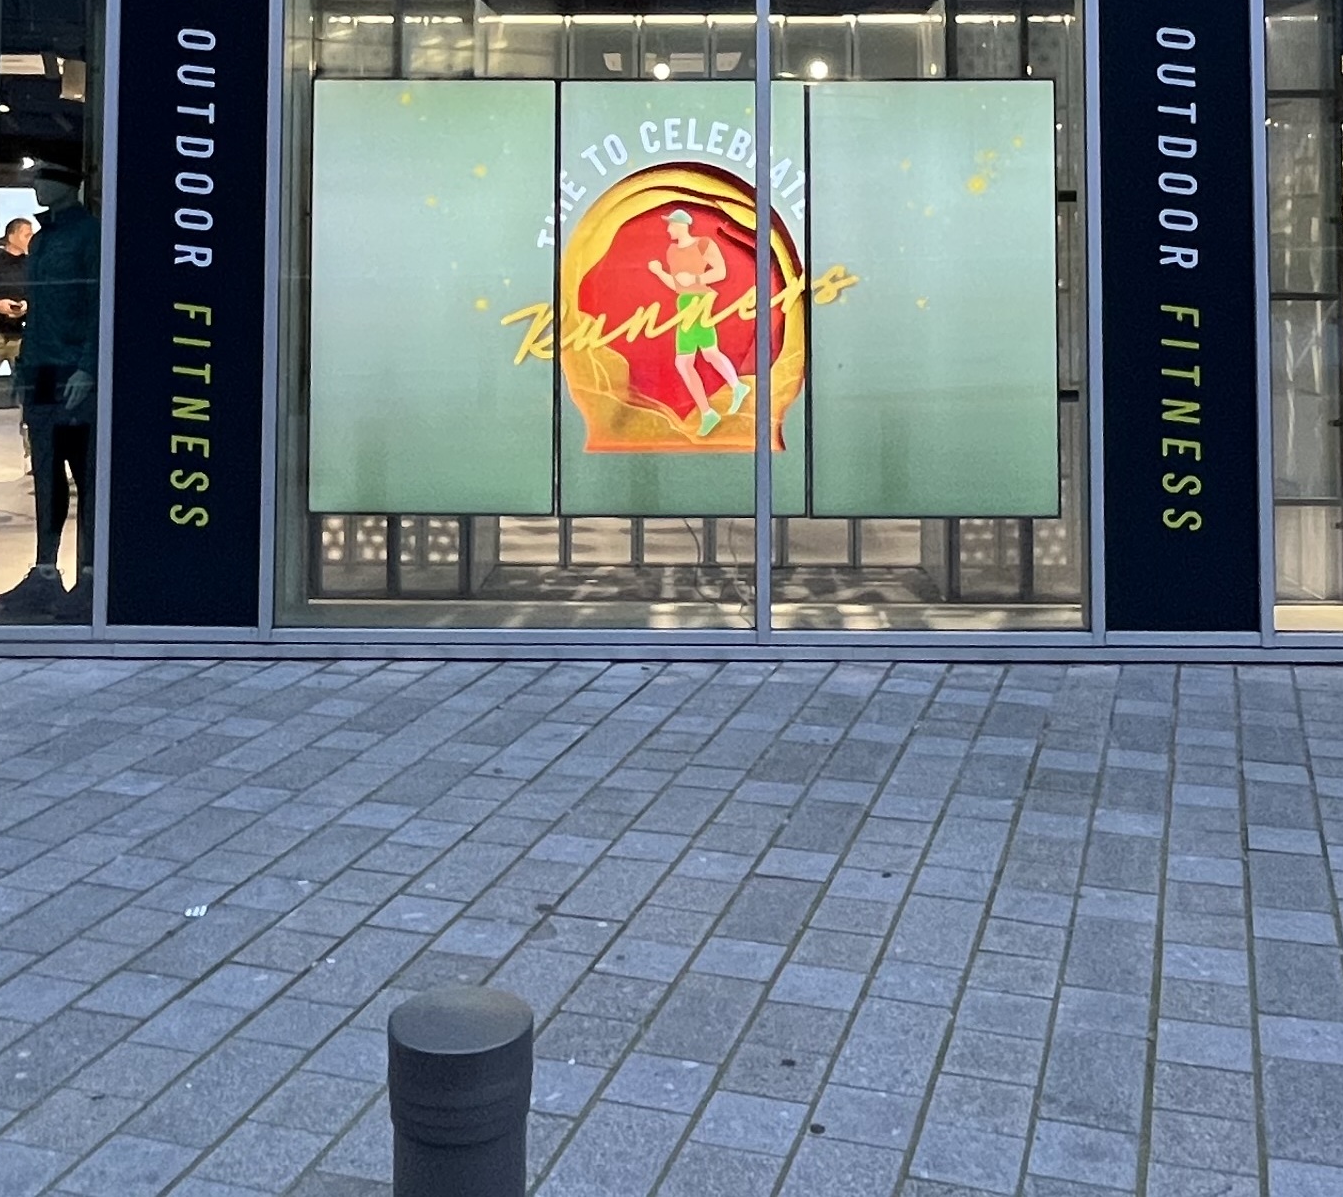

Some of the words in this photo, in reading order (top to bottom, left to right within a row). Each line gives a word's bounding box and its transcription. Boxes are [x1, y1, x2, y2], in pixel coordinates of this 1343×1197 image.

[173, 28, 217, 268] OUTDOOR
[580, 133, 628, 176] TO
[639, 117, 806, 221] CELEBAT
[1155, 26, 1199, 269] OUTDOOR
[169, 302, 212, 527] FITNESS
[1160, 304, 1202, 531] FITNESS
